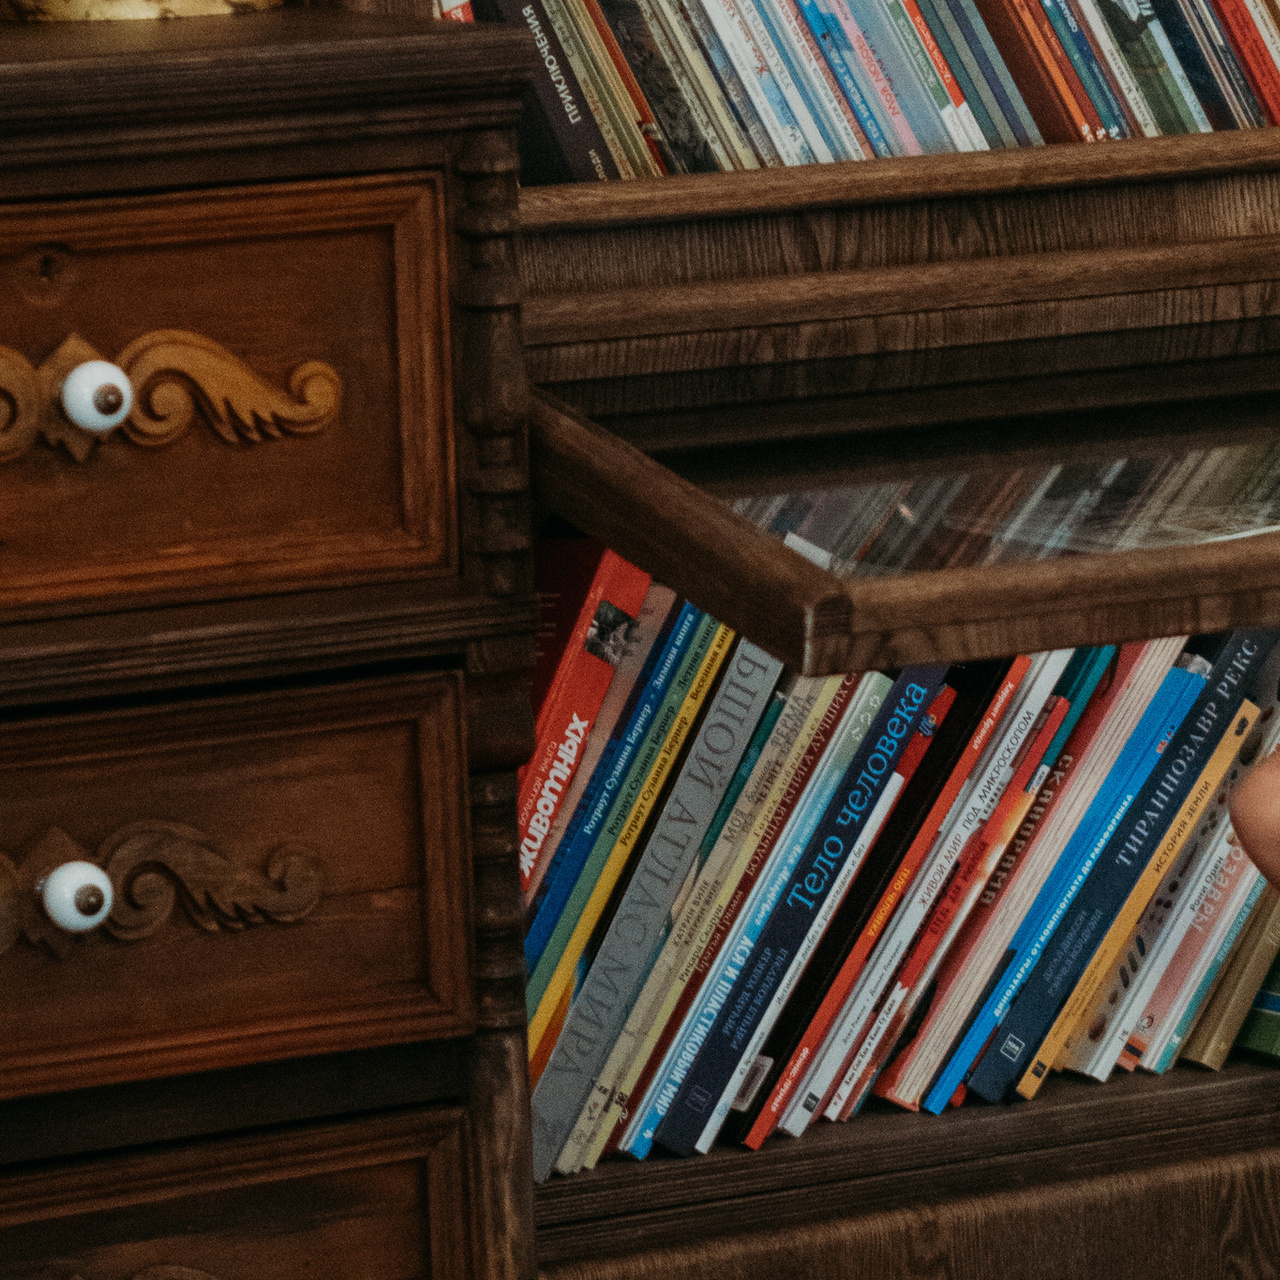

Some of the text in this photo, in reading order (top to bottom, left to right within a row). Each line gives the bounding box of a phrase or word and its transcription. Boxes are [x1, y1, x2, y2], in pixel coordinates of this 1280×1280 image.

[518, 3, 584, 125] ПРИКЛЮЧЕНИЯ
[747, 12, 776, 58] СМЕРТЬ
[842, 75, 880, 135] ПО ИМЕНИ
[582, 611, 695, 836] Ротраут Сузанна Бернер Зимняя книга
[606, 648, 702, 837] Ротраут Сузанна Бернер Летняя
[619, 647, 721, 847] Ротраут Сузанна Бернер Весенняя
[719, 692, 807, 845] МОЯ ФЕРМА
[742, 802, 790, 878] БОЛЬШАЯ
[779, 749, 816, 805] КНИГА
[807, 682, 851, 751] ЛУЧШИХ
[784, 828, 851, 917] Тело
[830, 677, 933, 833] человека
[1114, 636, 1261, 871] ТИРАННОЗАВР РЕКС
[609, 796, 704, 948] АТЛАС
[889, 865, 911, 893] ТЕЛО
[915, 704, 1036, 911] ЖИВОЙ МИР ПОД МИКРОСКОПОМ
[979, 747, 1075, 911] СКАНОРАМА
[1151, 778, 1214, 875] ИСТОРИЯ ЗЕМЛИ
[1186, 853, 1227, 913] Рони Орен
[864, 889, 898, 938] ЧЕЛОВЕКА
[990, 952, 1034, 1019] ДИНОЗАВРЫ:
[1028, 939, 1042, 956] ОТ
[1036, 870, 1085, 944] КОМПСОГНАТА
[1078, 858, 1094, 875] ДО
[1087, 789, 1134, 862] РАМФОРИНХА
[546, 950, 633, 1084] МИРА
[650, 933, 756, 1113] АСЯ И ПЛАСТИКОВЫЙ МИР
[718, 944, 777, 1037] РИЧАРД УОЛКЕР
[726, 1003, 761, 1051] РЭЙЧЕЛ
